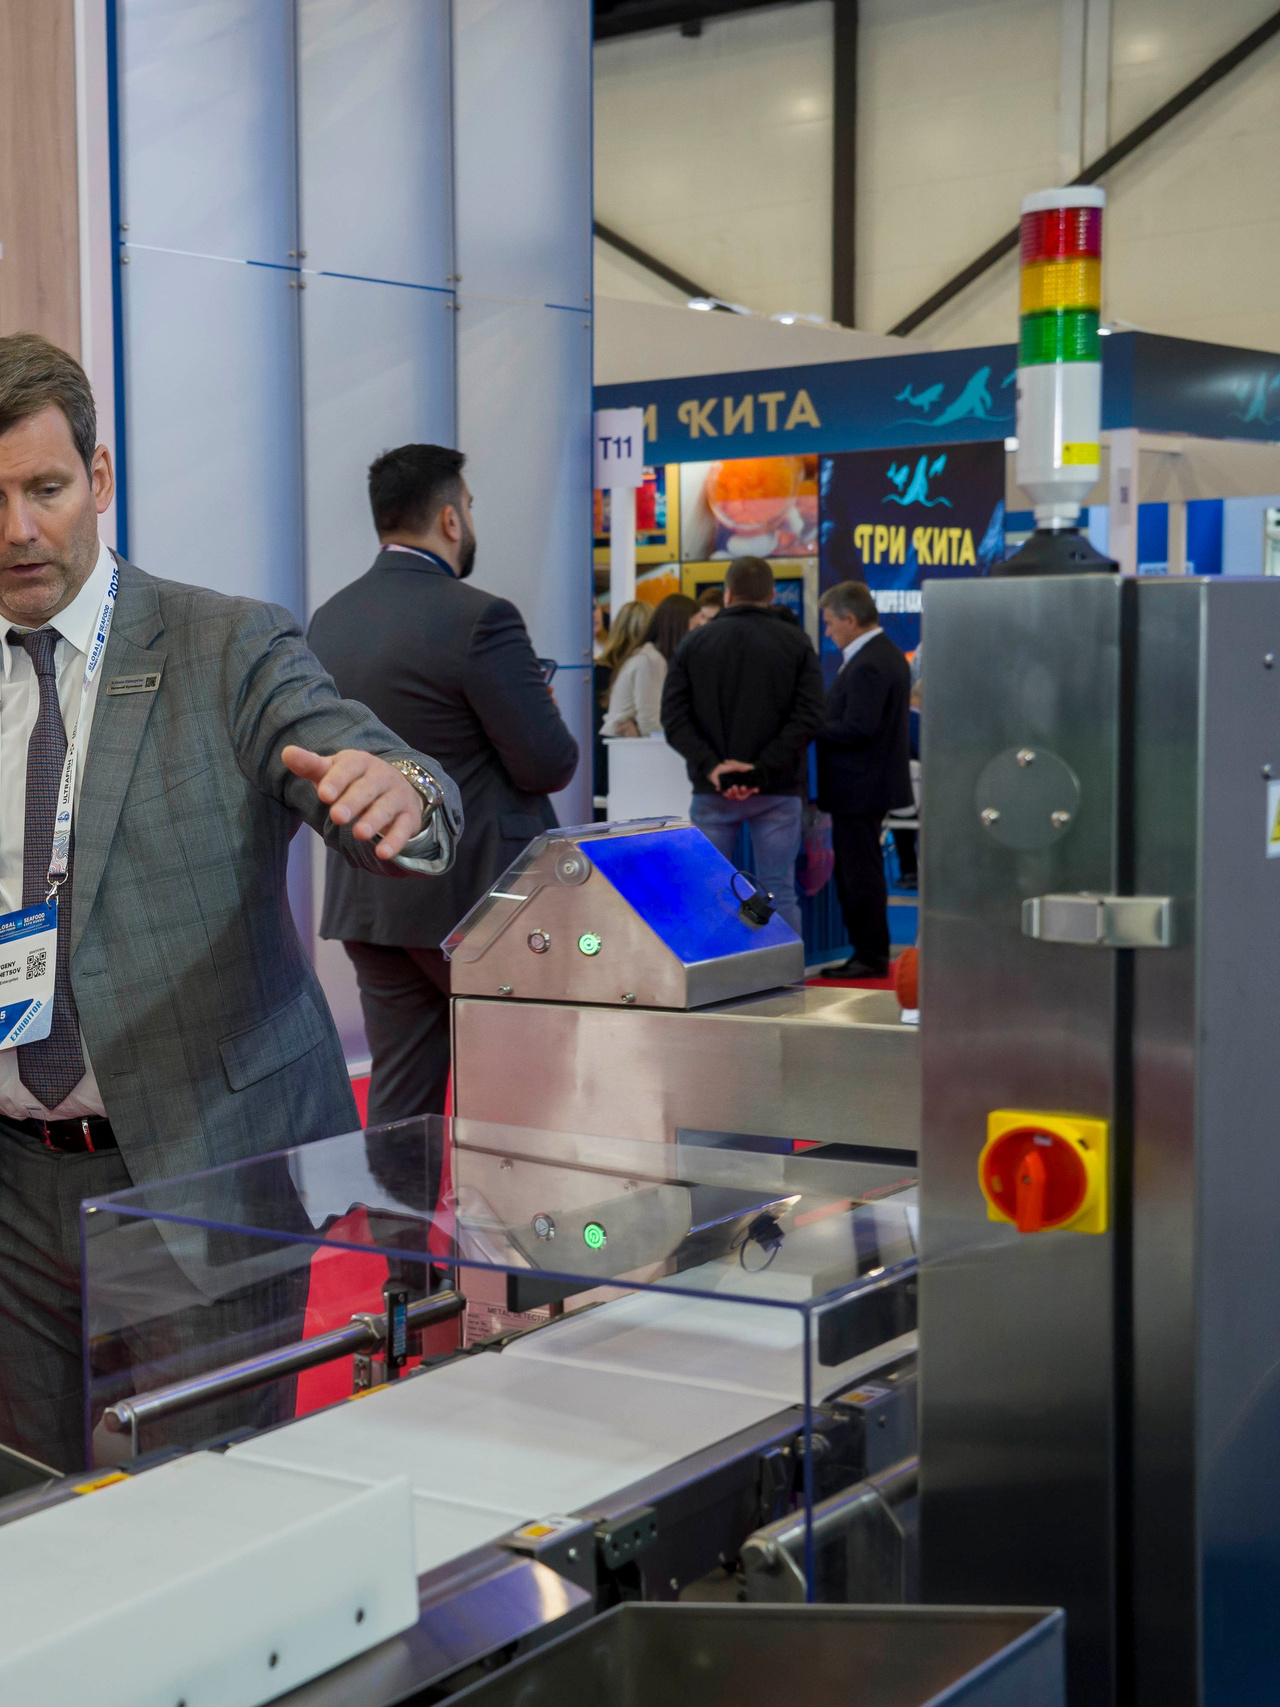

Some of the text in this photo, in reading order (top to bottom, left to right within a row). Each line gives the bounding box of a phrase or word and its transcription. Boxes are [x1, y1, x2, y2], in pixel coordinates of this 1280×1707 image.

[677, 389, 821, 440] КИТА
[598, 436, 632, 460] T11
[854, 524, 976, 566] ТРИ КИТА
[88, 568, 119, 671] GLOBAL SEAFOOD 2025
[63, 759, 72, 804] ULTRAFISH
[23, 913, 45, 923] SEAFOOD
[10, 1000, 43, 1042] EXHIBITOR
[514, 1311, 550, 1322] DETECTO
